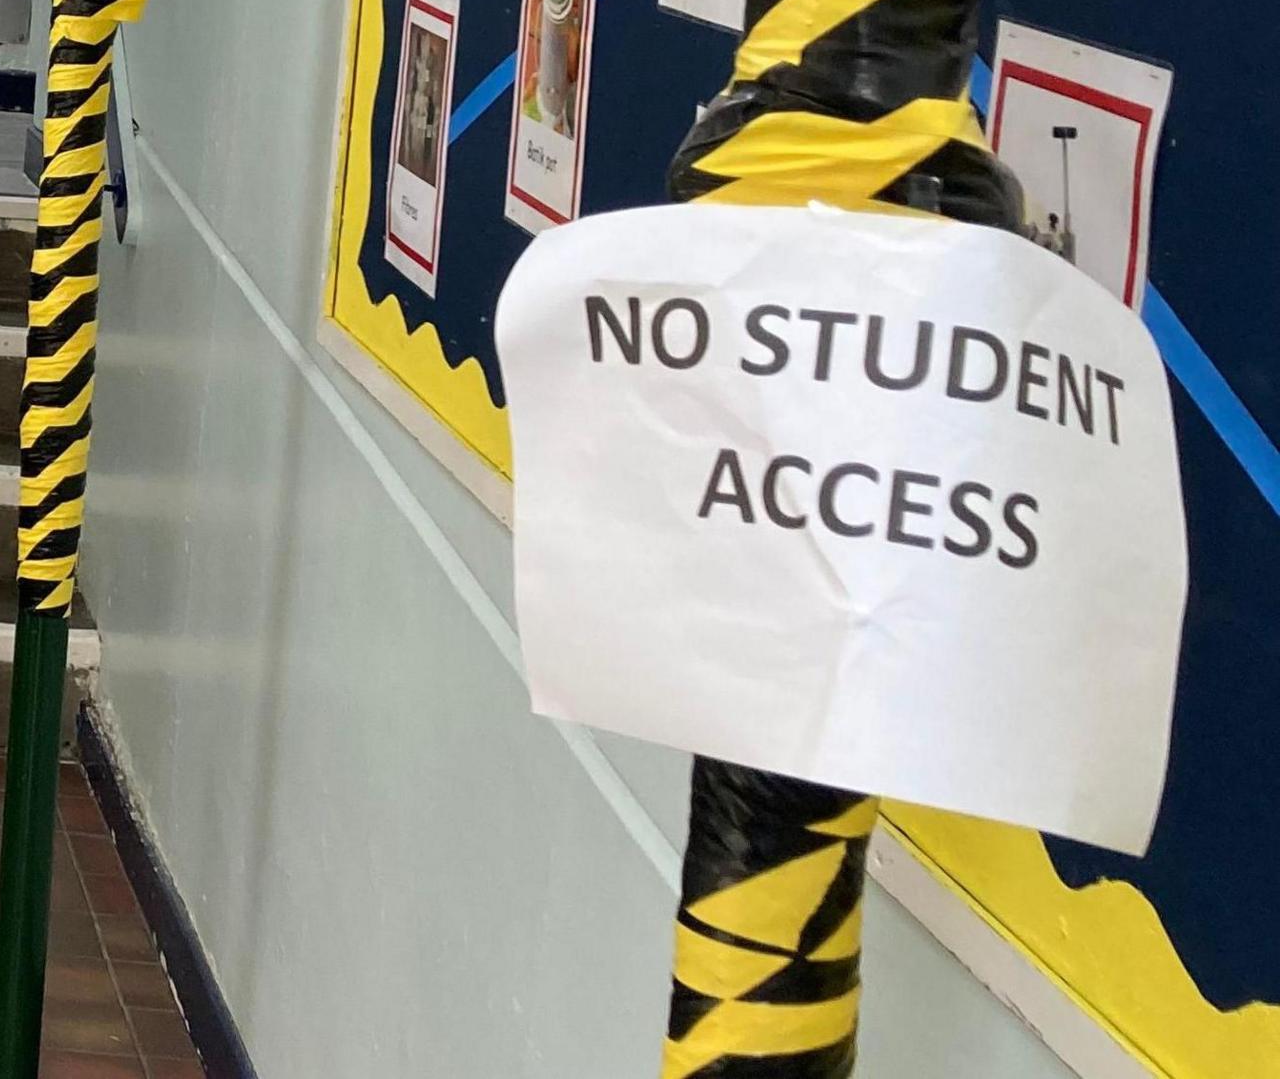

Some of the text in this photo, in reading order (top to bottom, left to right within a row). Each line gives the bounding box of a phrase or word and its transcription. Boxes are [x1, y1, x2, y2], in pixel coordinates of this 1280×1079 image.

[585, 295, 1125, 446] NO STUDENT
[697, 449, 1041, 569] ACCESS
